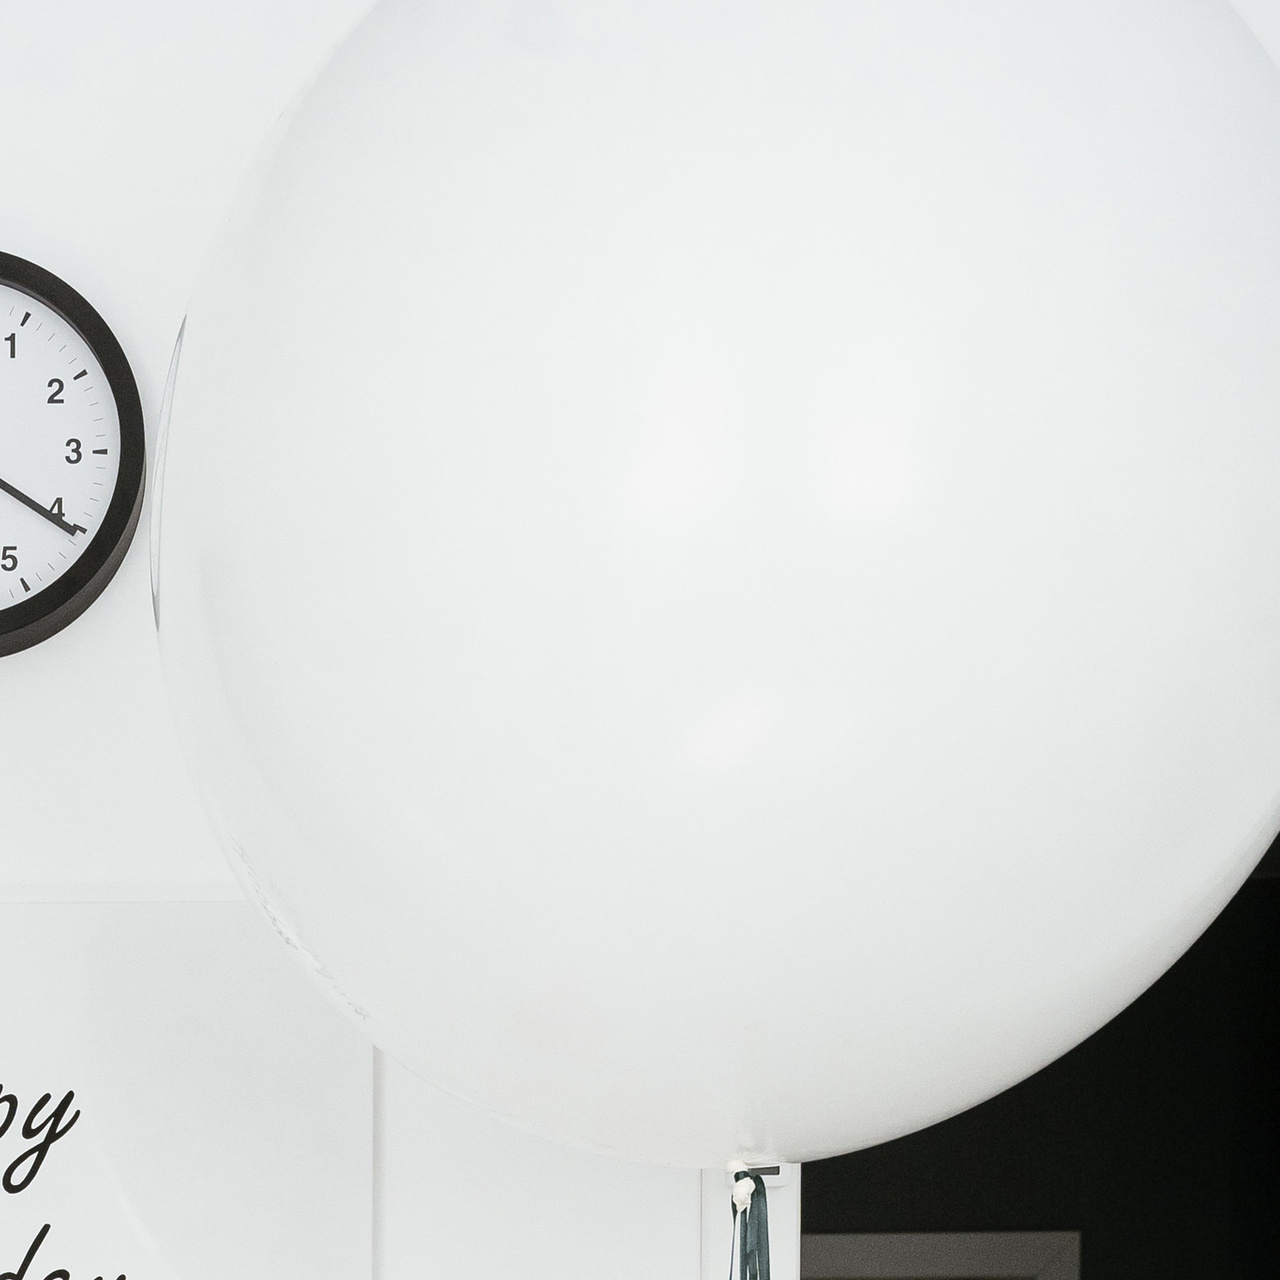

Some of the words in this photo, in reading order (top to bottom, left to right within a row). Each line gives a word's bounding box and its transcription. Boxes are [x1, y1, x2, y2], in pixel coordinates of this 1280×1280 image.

[4, 332, 16, 359] 1
[46, 378, 65, 404] 2
[64, 438, 83, 465] 3
[48, 497, 66, 520] 4
[0, 545, 18, 572] 5
